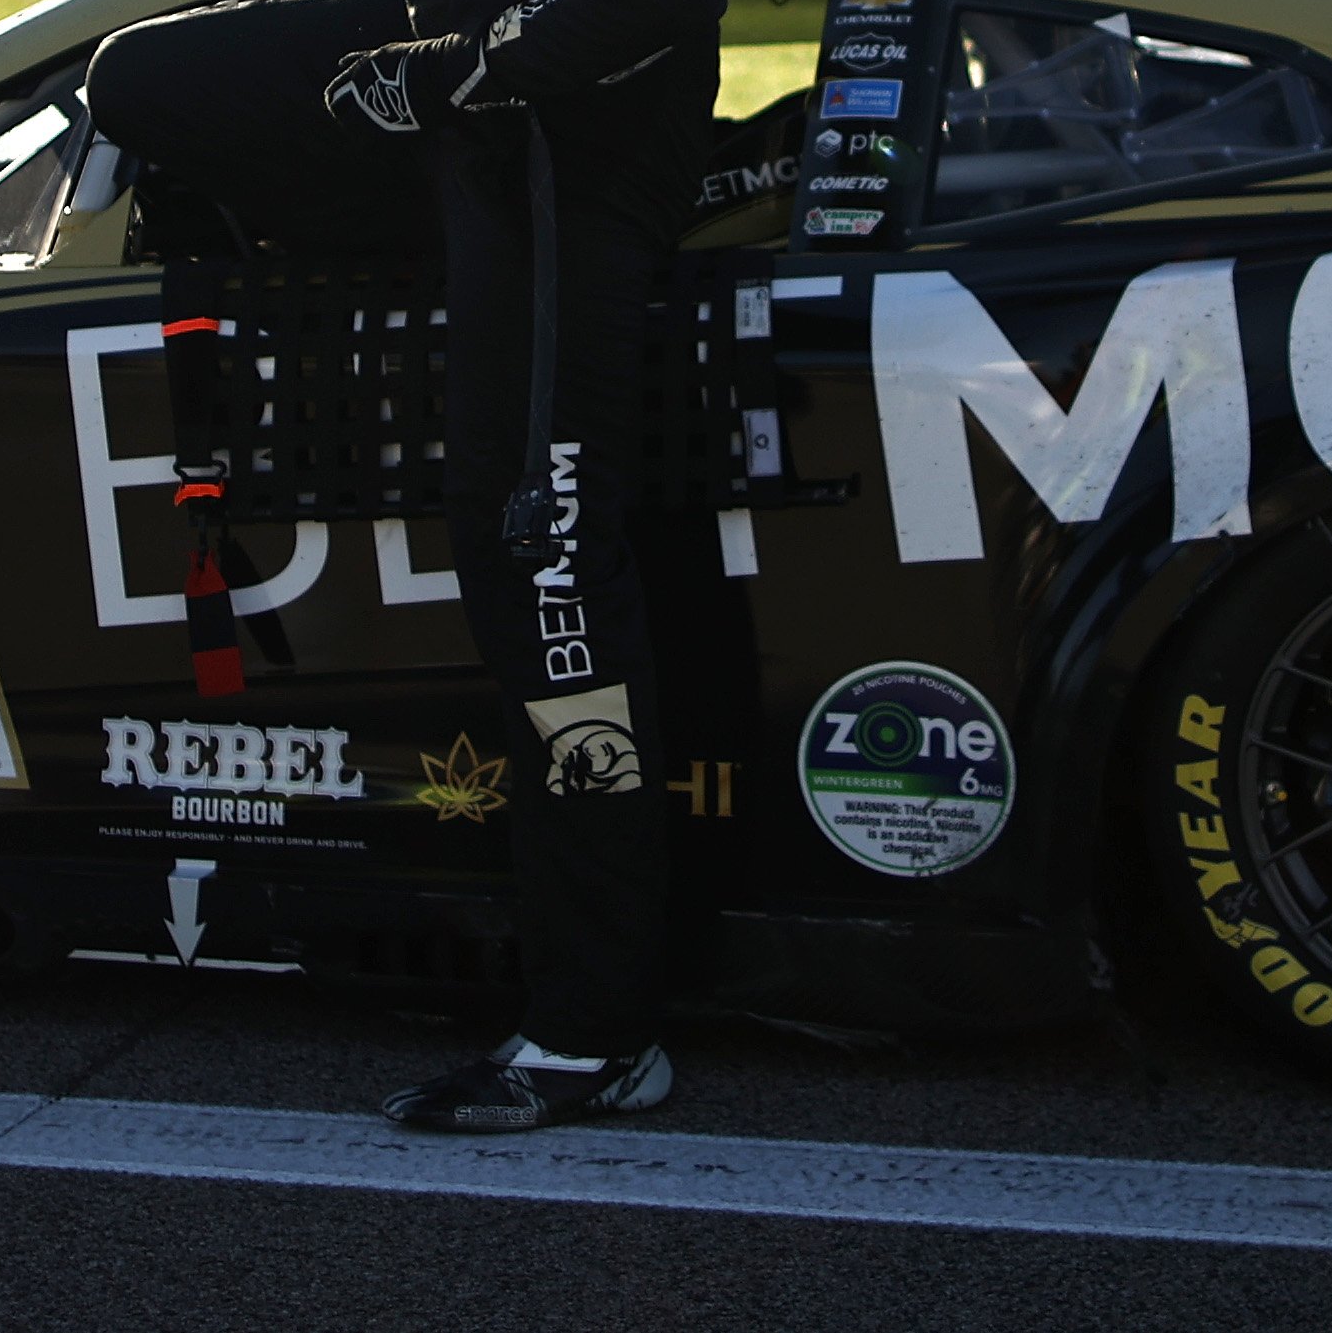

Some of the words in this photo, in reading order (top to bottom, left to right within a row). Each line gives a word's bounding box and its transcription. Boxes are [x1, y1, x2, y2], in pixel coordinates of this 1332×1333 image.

[835, 14, 913, 26] CHEVROLET
[830, 43, 881, 60] LUCAS
[882, 44, 907, 60] OIL
[847, 129, 895, 157] ptc
[695, 155, 801, 207] ETMG
[809, 176, 890, 192] COMETIC
[866, 674, 917, 690] NICOTINE
[919, 676, 968, 706] POUCHES
[824, 707, 997, 763] zone
[100, 714, 365, 801] REBEL
[813, 775, 903, 789] WINTERGREEN
[170, 795, 286, 827] BOURBON
